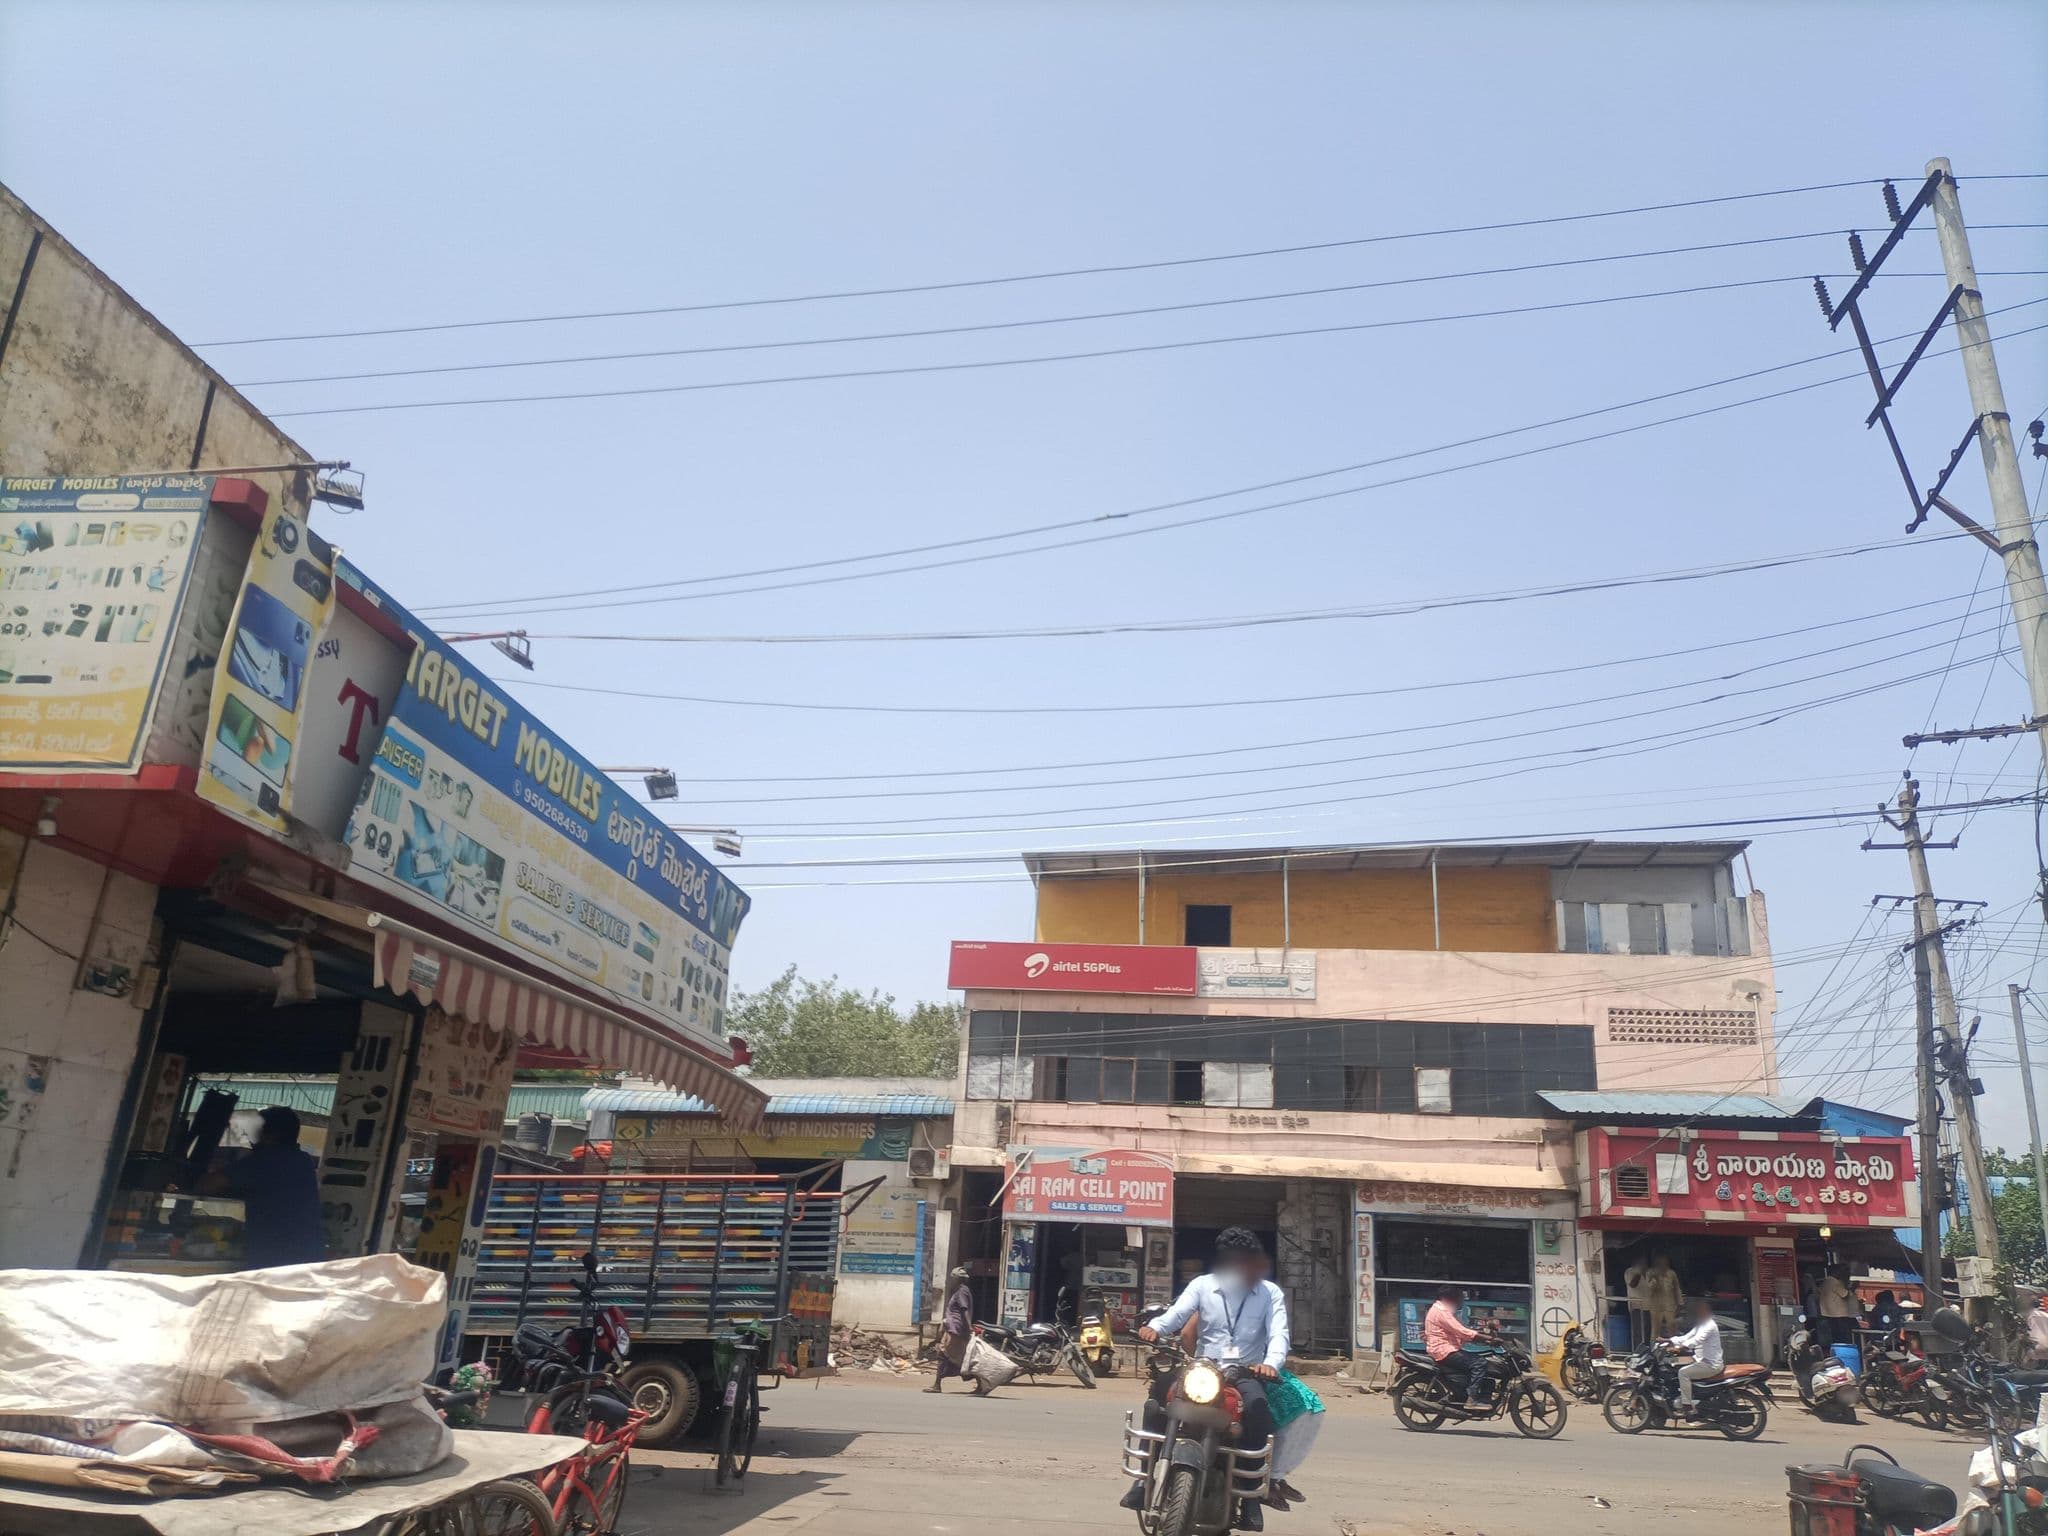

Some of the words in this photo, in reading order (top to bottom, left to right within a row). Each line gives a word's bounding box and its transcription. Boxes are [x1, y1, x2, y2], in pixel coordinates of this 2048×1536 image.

[6, 478, 56, 490] TARGET
[62, 477, 119, 490] MOBILES
[406, 629, 508, 748] TARGET
[514, 721, 602, 823] MOBILES
[523, 788, 588, 843] 9502684530
[514, 861, 564, 909] SALES
[565, 892, 575, 914] &
[578, 899, 632, 949] SERVICE
[1052, 960, 1081, 972] airtel
[650, 1119, 671, 1135] SRI
[674, 1119, 718, 1136] SAMBA
[801, 1121, 876, 1140] INDUSTRIES
[1692, 1144, 1712, 1181] శ్రీ
[1716, 1153, 1826, 1179] నారాయణ
[1834, 1151, 1895, 1186] స్వామి
[1012, 1176, 1037, 1197] SAI
[1041, 1176, 1076, 1198] RAM
[1080, 1178, 1114, 1199] CELL
[1119, 1180, 1168, 1201] POINT
[1051, 1201, 1078, 1211] SALES
[1079, 1202, 1086, 1211] &
[1087, 1203, 1124, 1212] SERVICE
[1357, 1216, 1373, 1318] MEDICAL
